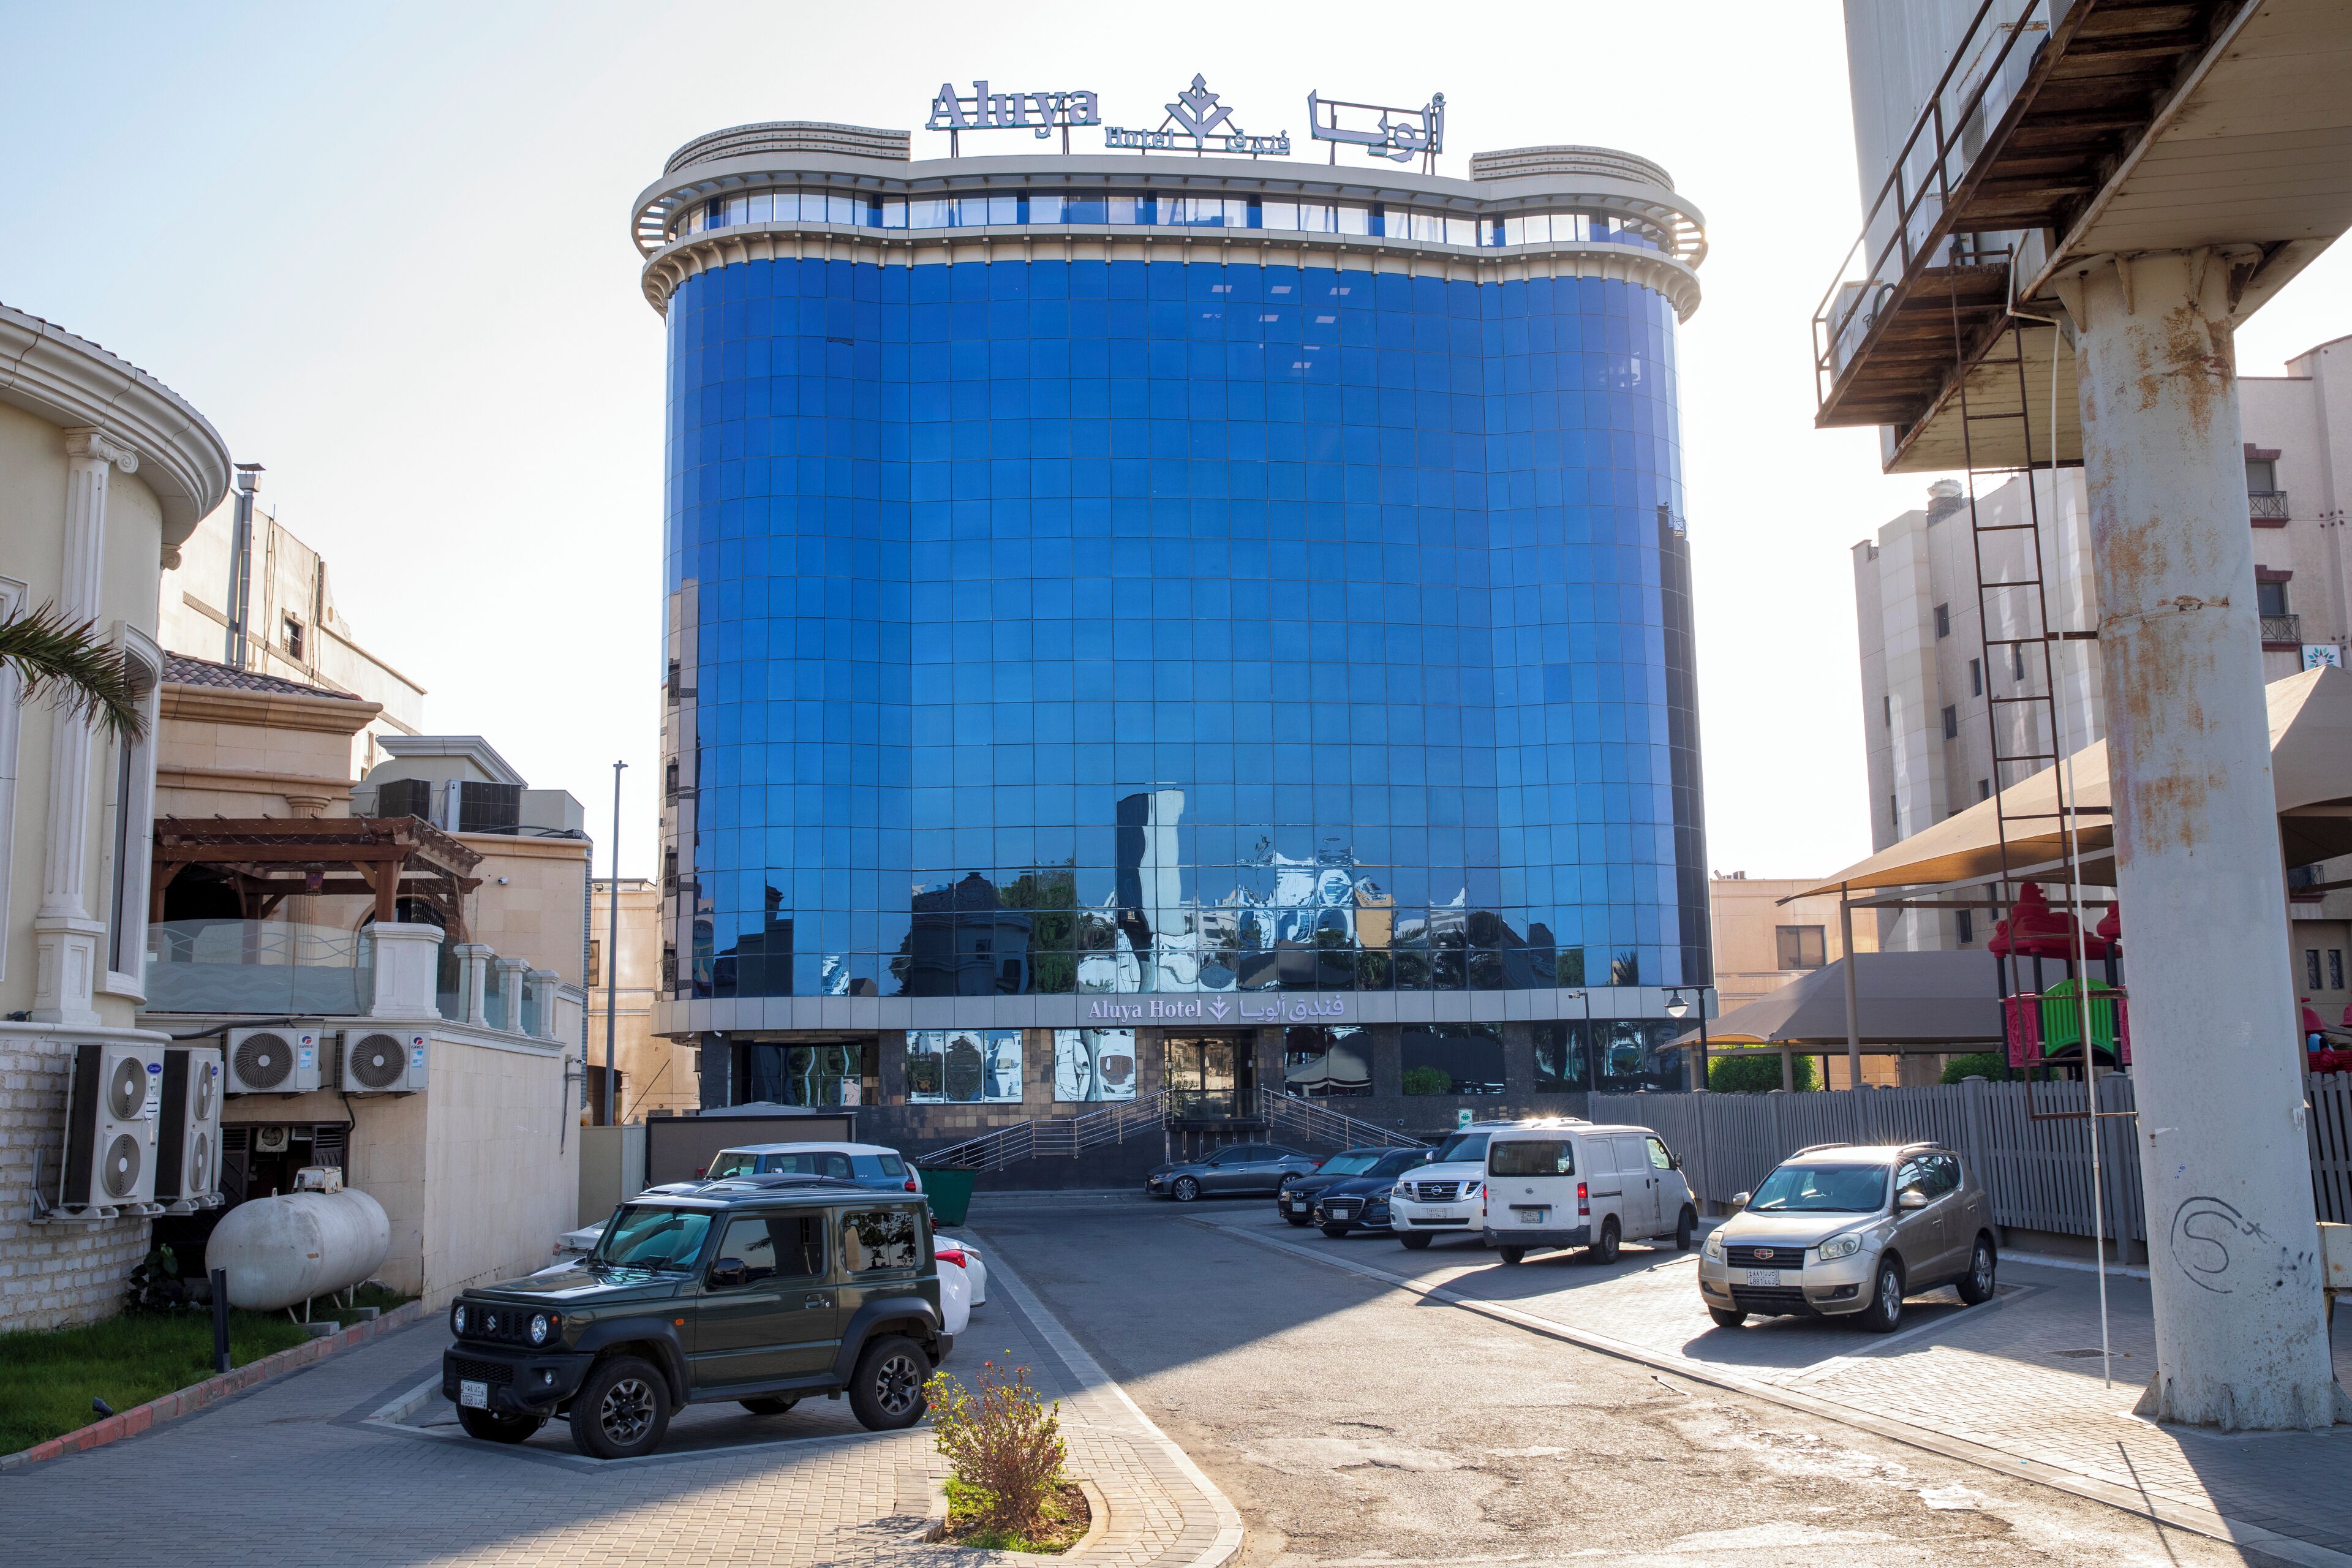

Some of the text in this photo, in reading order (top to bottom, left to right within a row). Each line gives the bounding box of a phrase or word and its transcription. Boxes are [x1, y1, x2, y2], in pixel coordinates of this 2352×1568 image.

[925, 80, 1175, 149] Aluya Hotel
[1225, 129, 1291, 154] فندق
[1088, 1000, 1202, 1022] Aluya Hotel
[1240, 994, 1344, 1022] فندق ألويا
[462, 1393, 473, 1406] 1058
